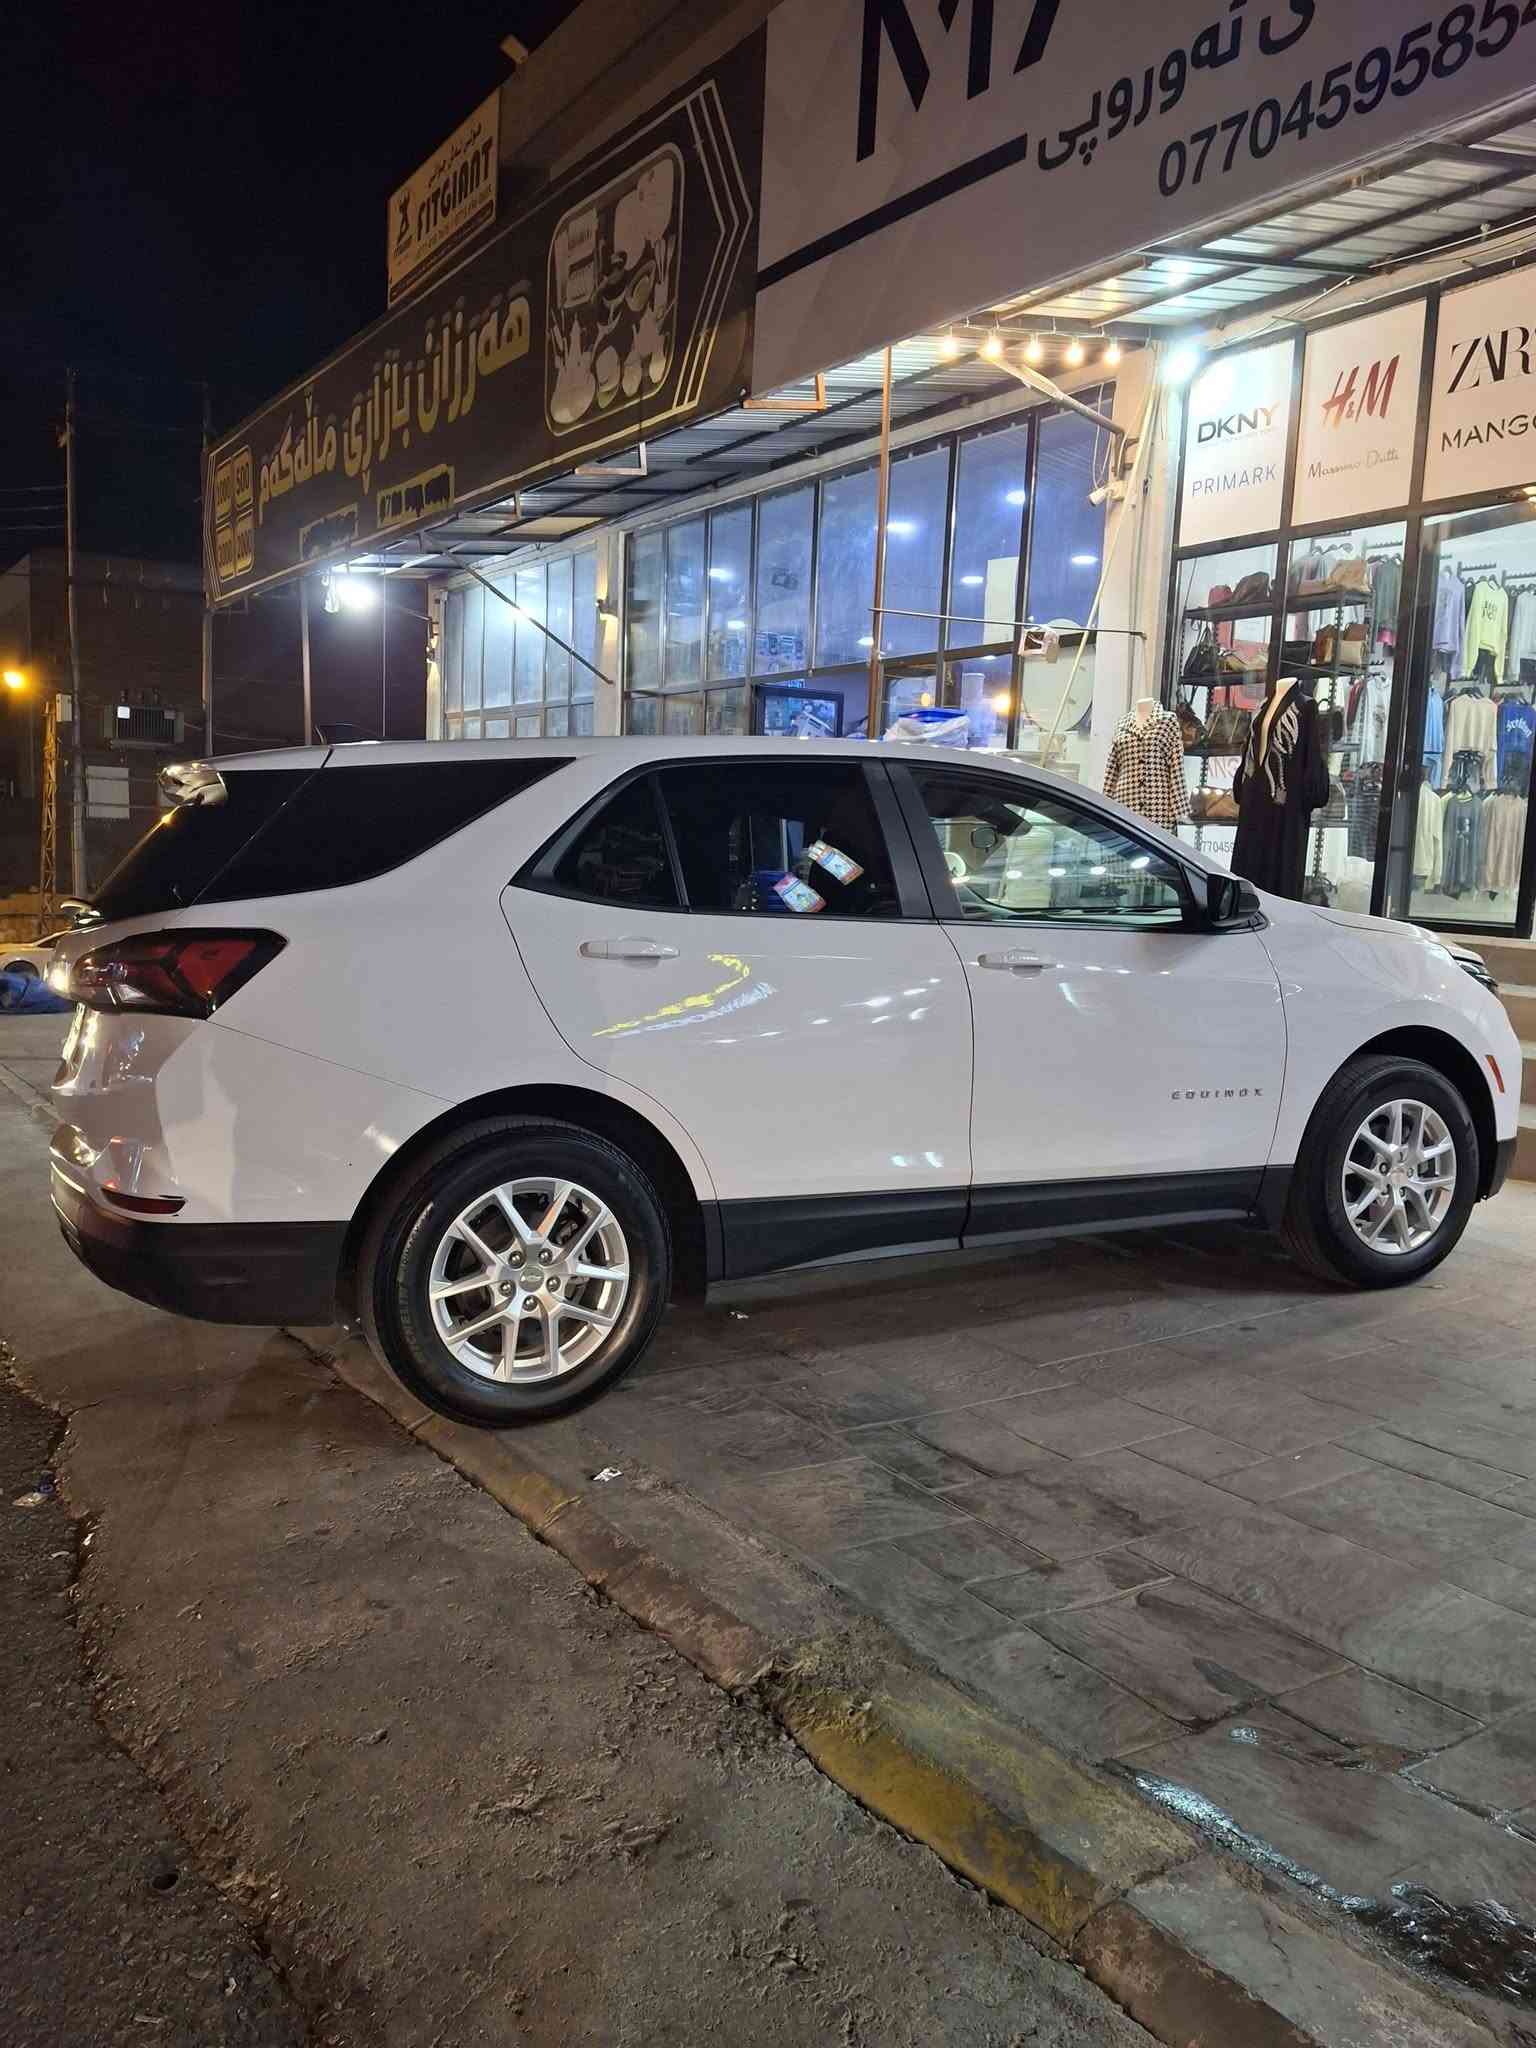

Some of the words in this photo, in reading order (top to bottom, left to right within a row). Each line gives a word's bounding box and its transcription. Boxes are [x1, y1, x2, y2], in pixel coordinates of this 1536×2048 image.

[1447, 326, 1536, 393] ZAR
[1321, 353, 1401, 431] H&M
[1197, 402, 1280, 443] DKNY
[1441, 414, 1536, 452] MANG
[1191, 463, 1276, 499] PRIMARK
[1171, 1087, 1264, 1100] EQUINOX
